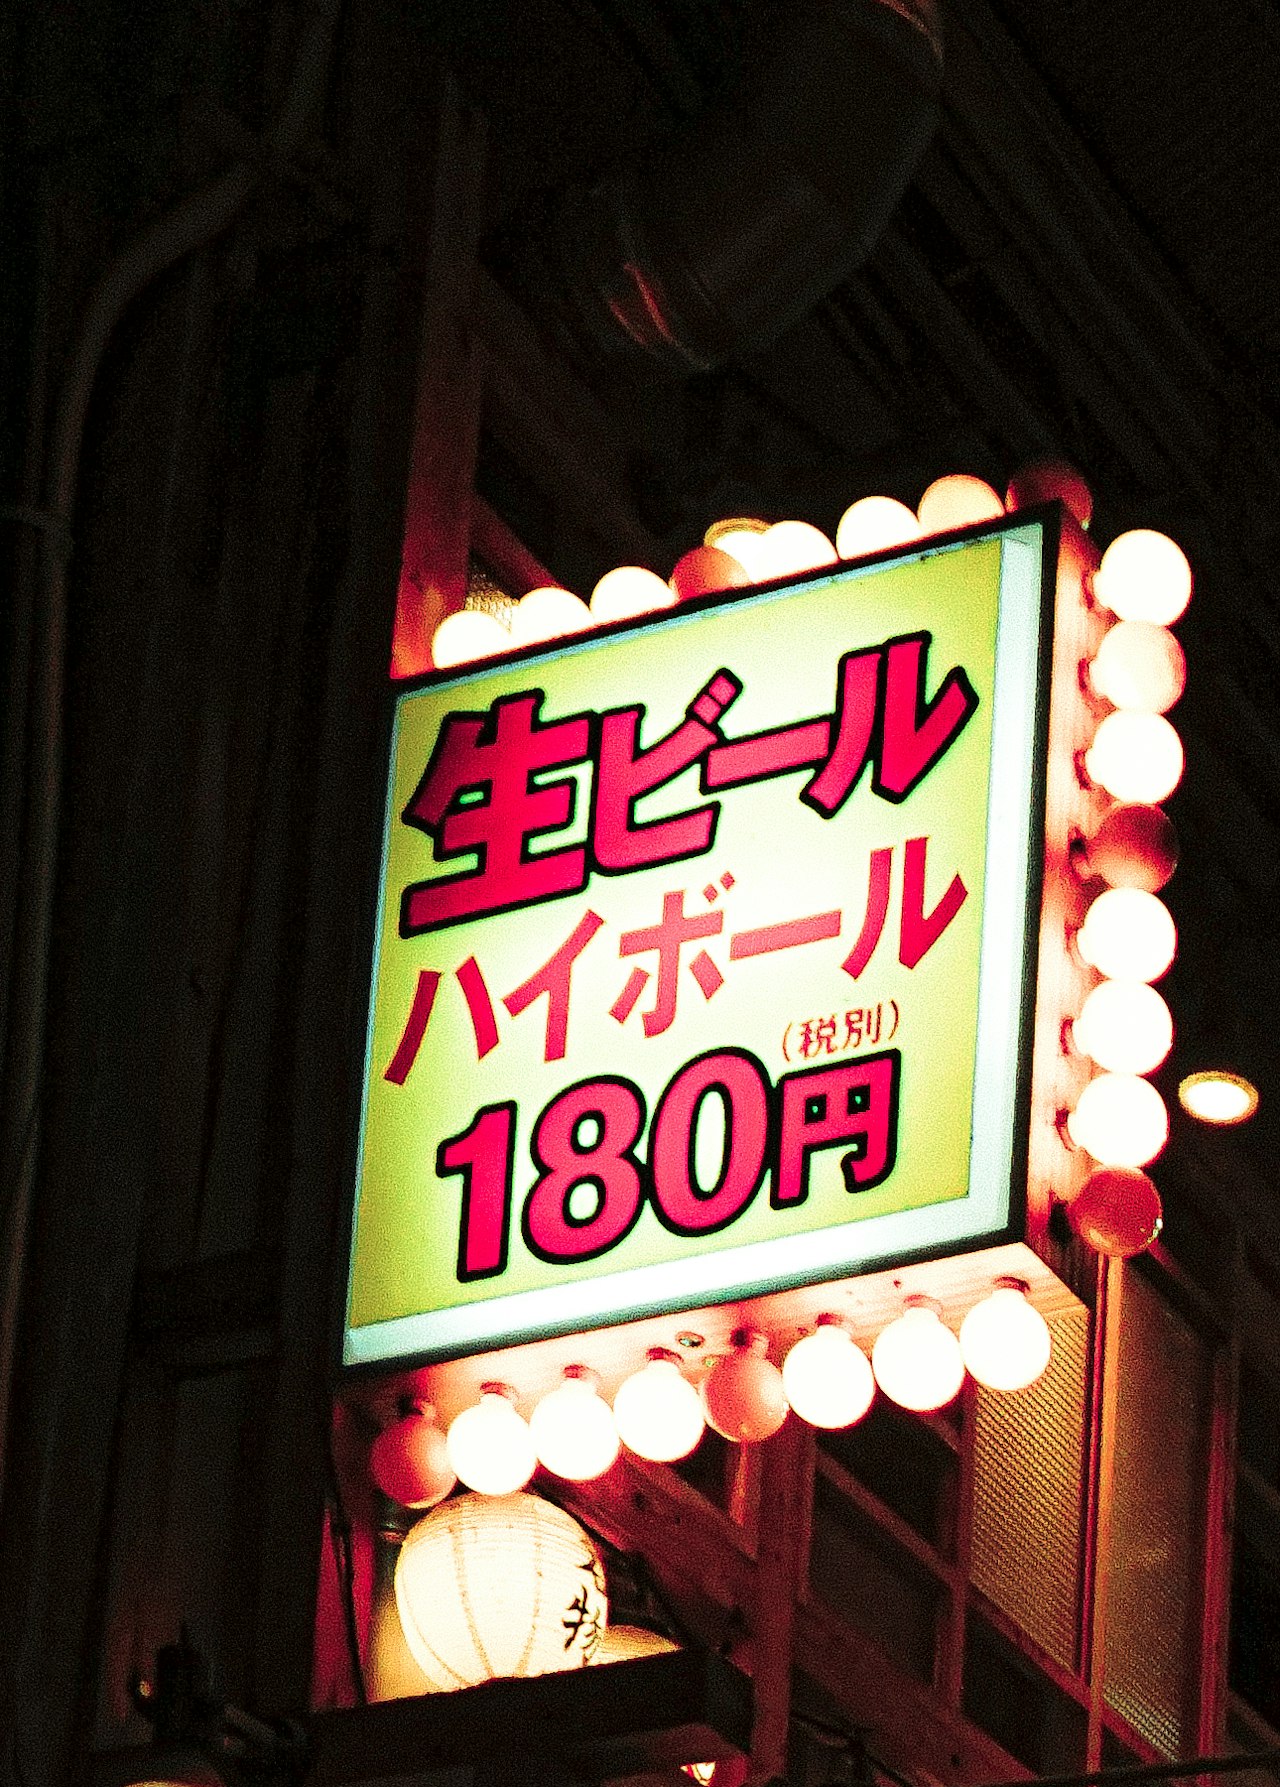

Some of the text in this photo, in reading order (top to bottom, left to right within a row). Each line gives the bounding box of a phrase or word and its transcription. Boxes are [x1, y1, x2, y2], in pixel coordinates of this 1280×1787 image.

[401, 633, 979, 937] 生ビール
[384, 836, 969, 1085] ハイボール
[780, 1000, 903, 1060] (税別)
[436, 1044, 903, 1282] 180円
